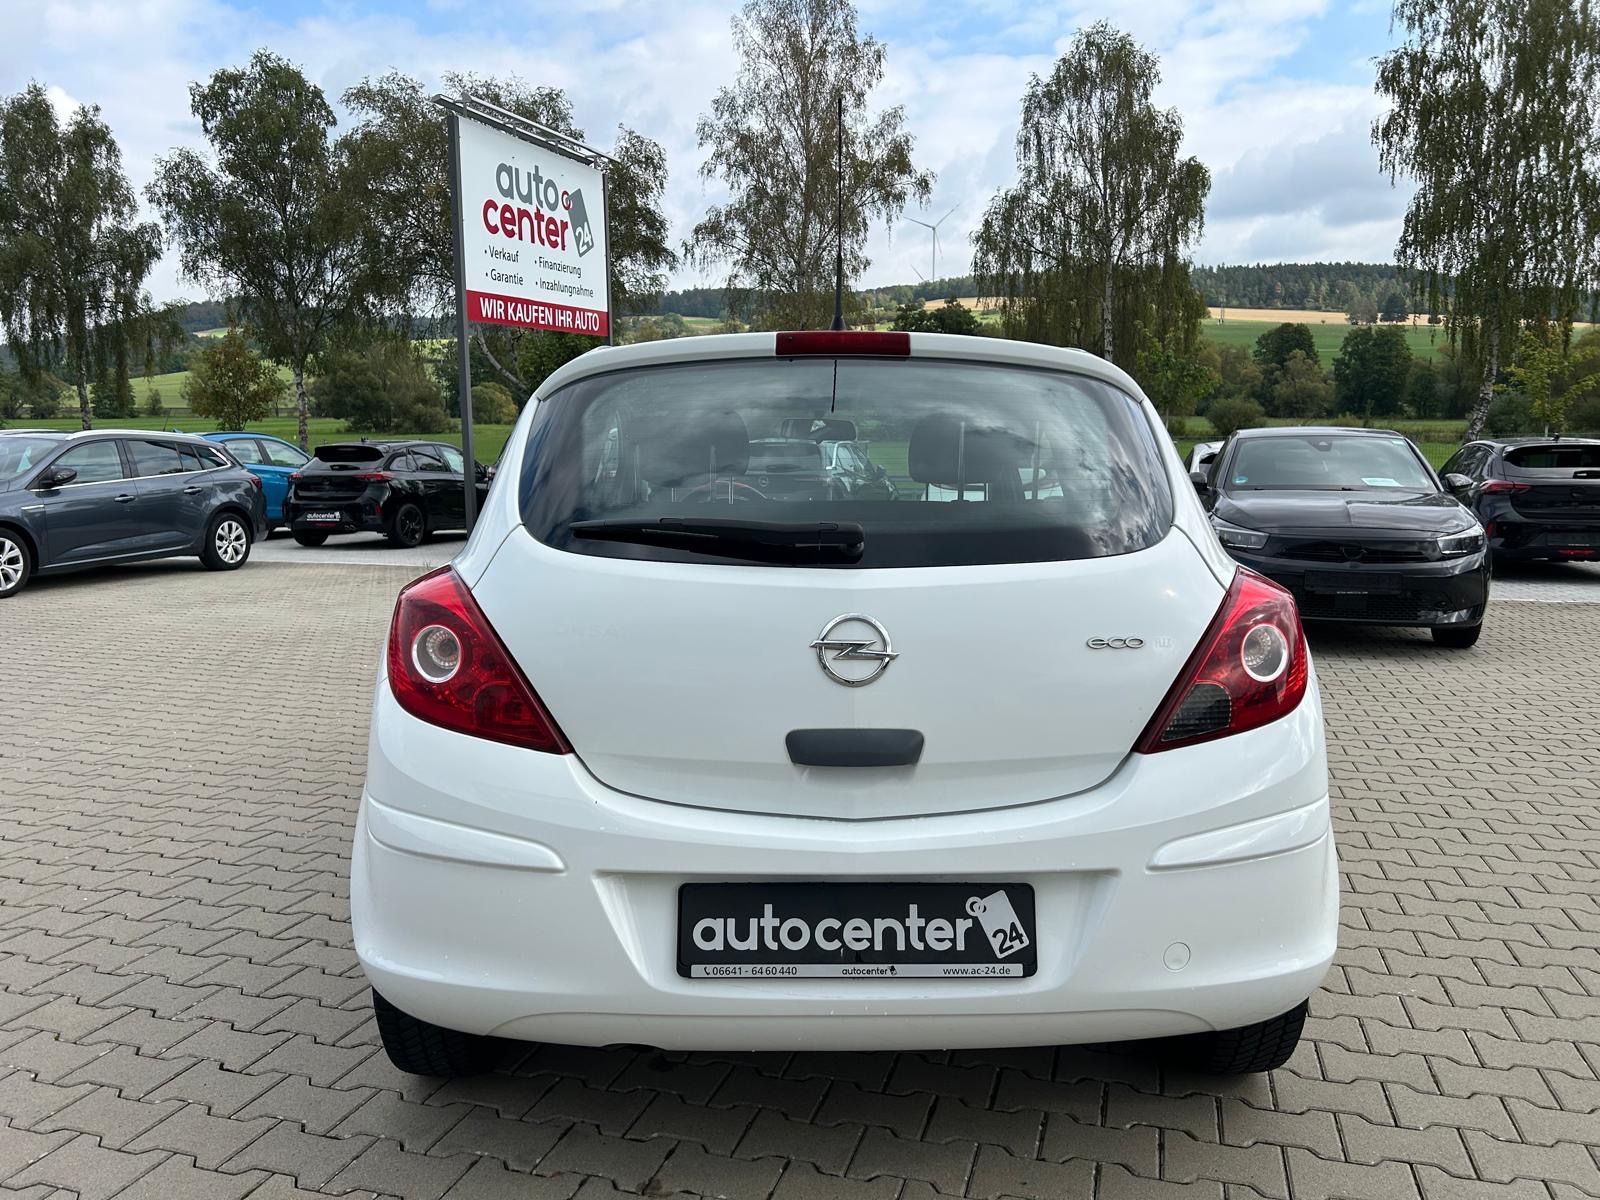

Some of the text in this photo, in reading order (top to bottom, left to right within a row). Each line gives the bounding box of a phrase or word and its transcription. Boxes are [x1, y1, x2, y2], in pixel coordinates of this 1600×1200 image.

[496, 162, 559, 211] auto
[483, 199, 569, 251] center
[575, 222, 592, 251] 24
[488, 245, 519, 263] Verkauf
[538, 256, 582, 278] Finanzierung
[490, 269, 524, 286] Garantie
[480, 297, 599, 331] WIR KAUFEN IHR AUTO
[1087, 636, 1144, 649] eco
[991, 921, 1025, 953] 24
[712, 966, 742, 976] 06641
[841, 967, 888, 976] autocenter
[943, 966, 1011, 976] www.ac-24.de
